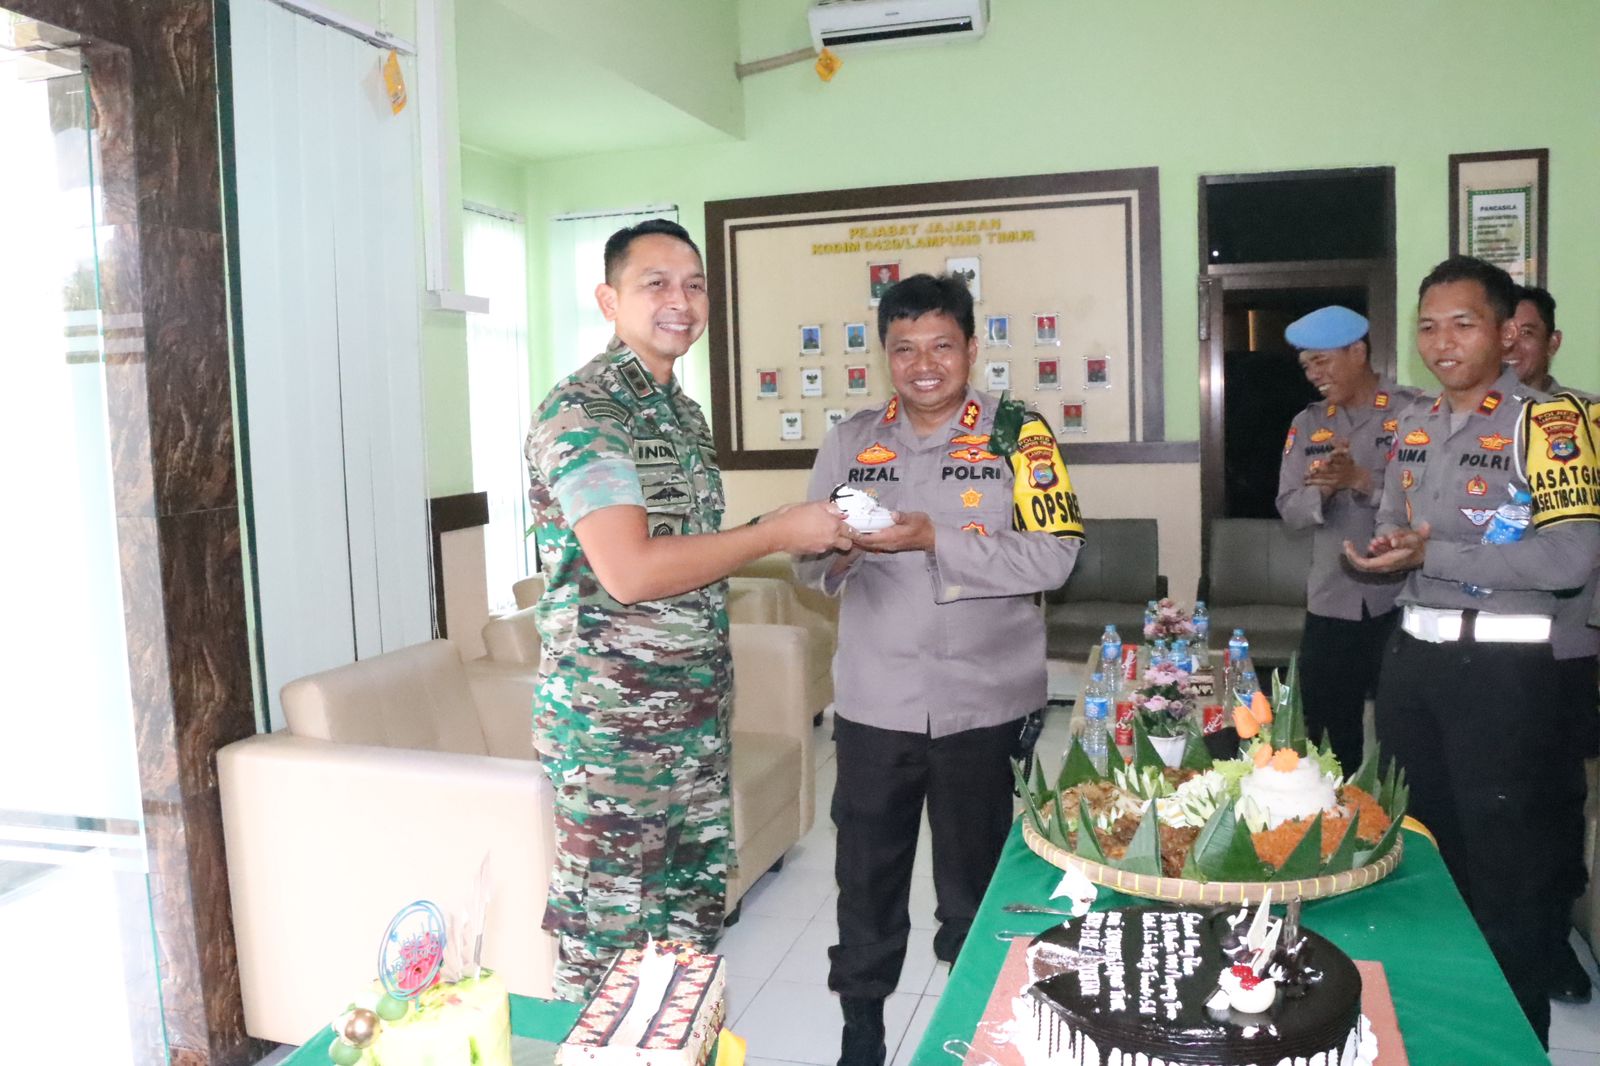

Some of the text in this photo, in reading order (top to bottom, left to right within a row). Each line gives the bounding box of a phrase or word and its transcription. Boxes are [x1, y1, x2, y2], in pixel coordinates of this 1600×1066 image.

[849, 223, 919, 239] PEJABAT
[1459, 453, 1511, 471] POLRI
[848, 467, 900, 483] RIZAL
[942, 466, 1001, 480] POLRI
